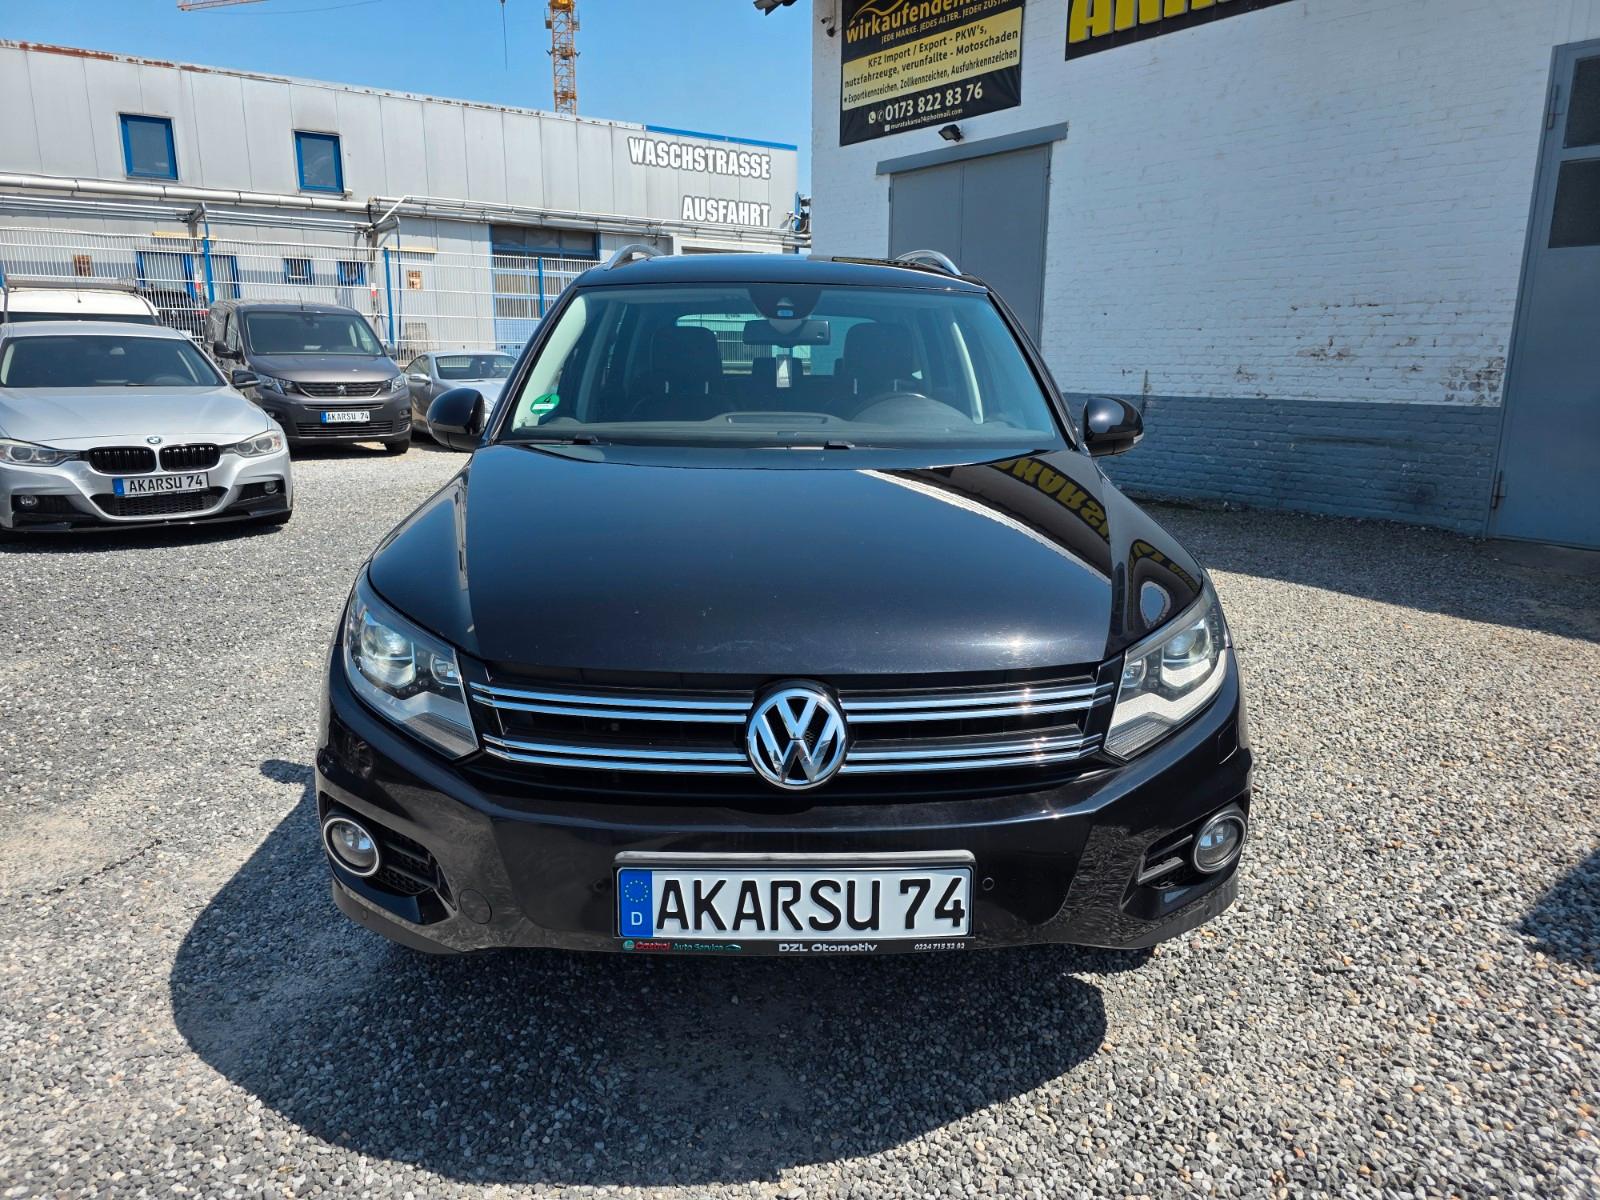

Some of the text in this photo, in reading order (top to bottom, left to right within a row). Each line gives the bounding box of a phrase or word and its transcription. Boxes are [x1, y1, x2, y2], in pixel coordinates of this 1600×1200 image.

[881, 31, 895, 44] JEDE
[920, 18, 937, 32] JEDES
[939, 11, 962, 25] ALTER.
[962, 4, 982, 18] JEDER
[868, 55, 882, 68] KFZ
[884, 47, 911, 63] Import
[919, 36, 947, 53] Export
[955, 24, 987, 42] PKW's,
[901, 52, 948, 72] verunfallte
[956, 30, 1018, 56] Motoschaden
[951, 48, 1018, 76] Ausfuhrkennzeichen
[885, 82, 983, 121] 0173 822 83 76
[628, 136, 771, 180] WASCHSTRASSE
[682, 195, 771, 228] AUSFAHRT
[327, 411, 369, 421] AKARSU 74
[129, 477, 182, 493] AKARSU
[186, 474, 203, 488] 74
[631, 911, 643, 926] D
[655, 876, 966, 932] AKARSU 74
[779, 942, 878, 952] DZL Otomotiv
